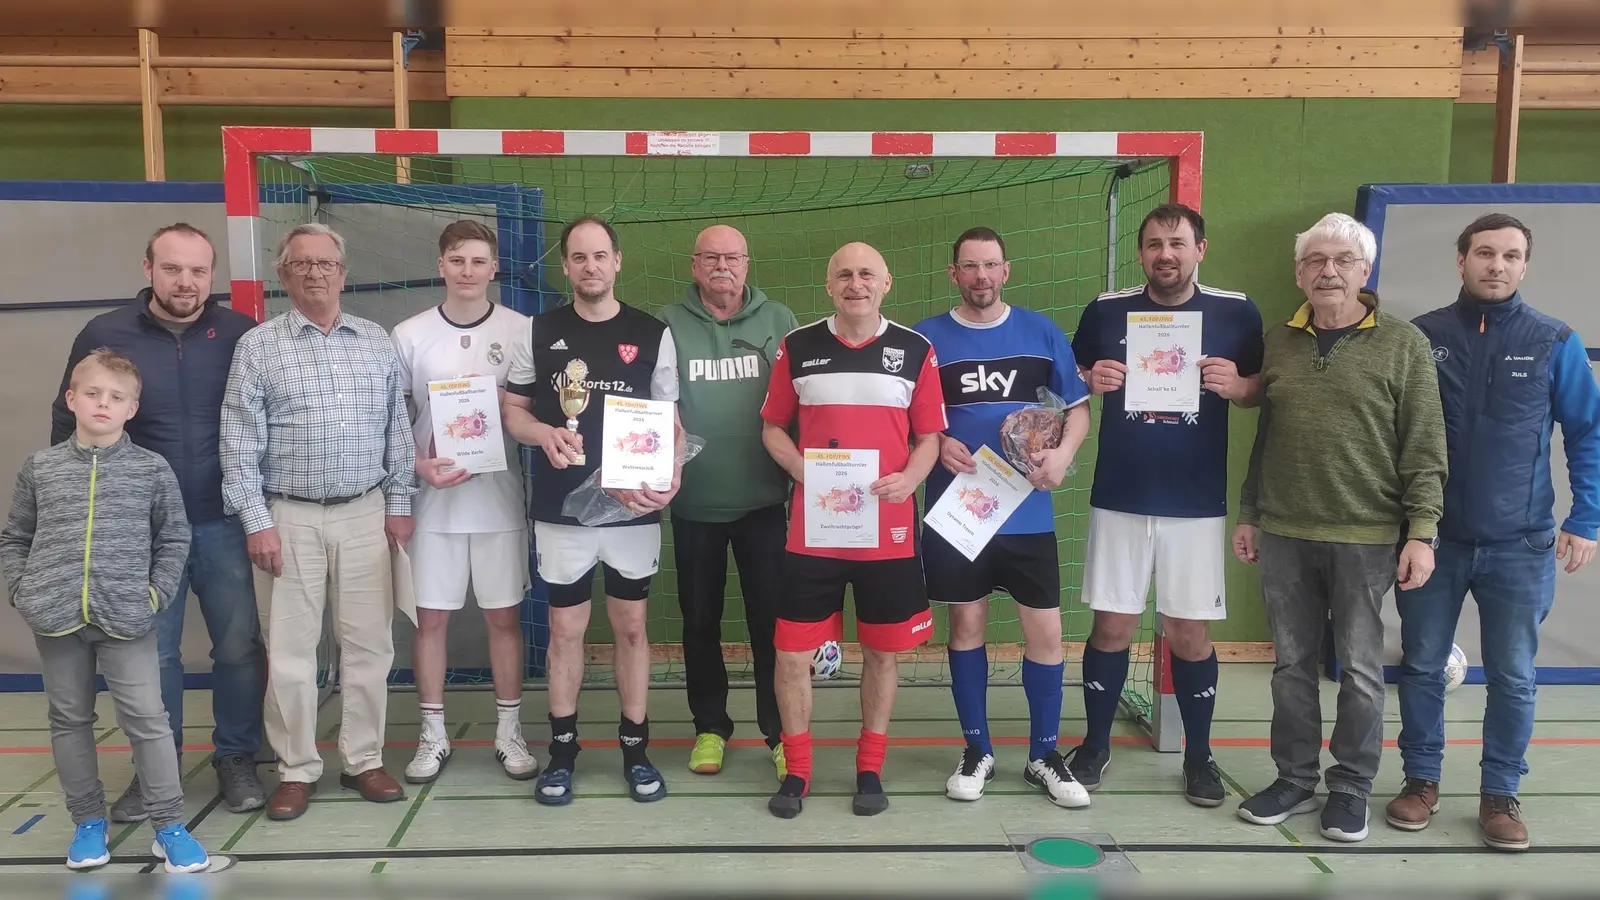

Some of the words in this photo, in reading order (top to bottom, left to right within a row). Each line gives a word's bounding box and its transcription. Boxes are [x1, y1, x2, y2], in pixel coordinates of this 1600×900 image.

[689, 355, 759, 381] PUMA
[801, 358, 831, 368] saller
[960, 364, 1018, 397] sky
